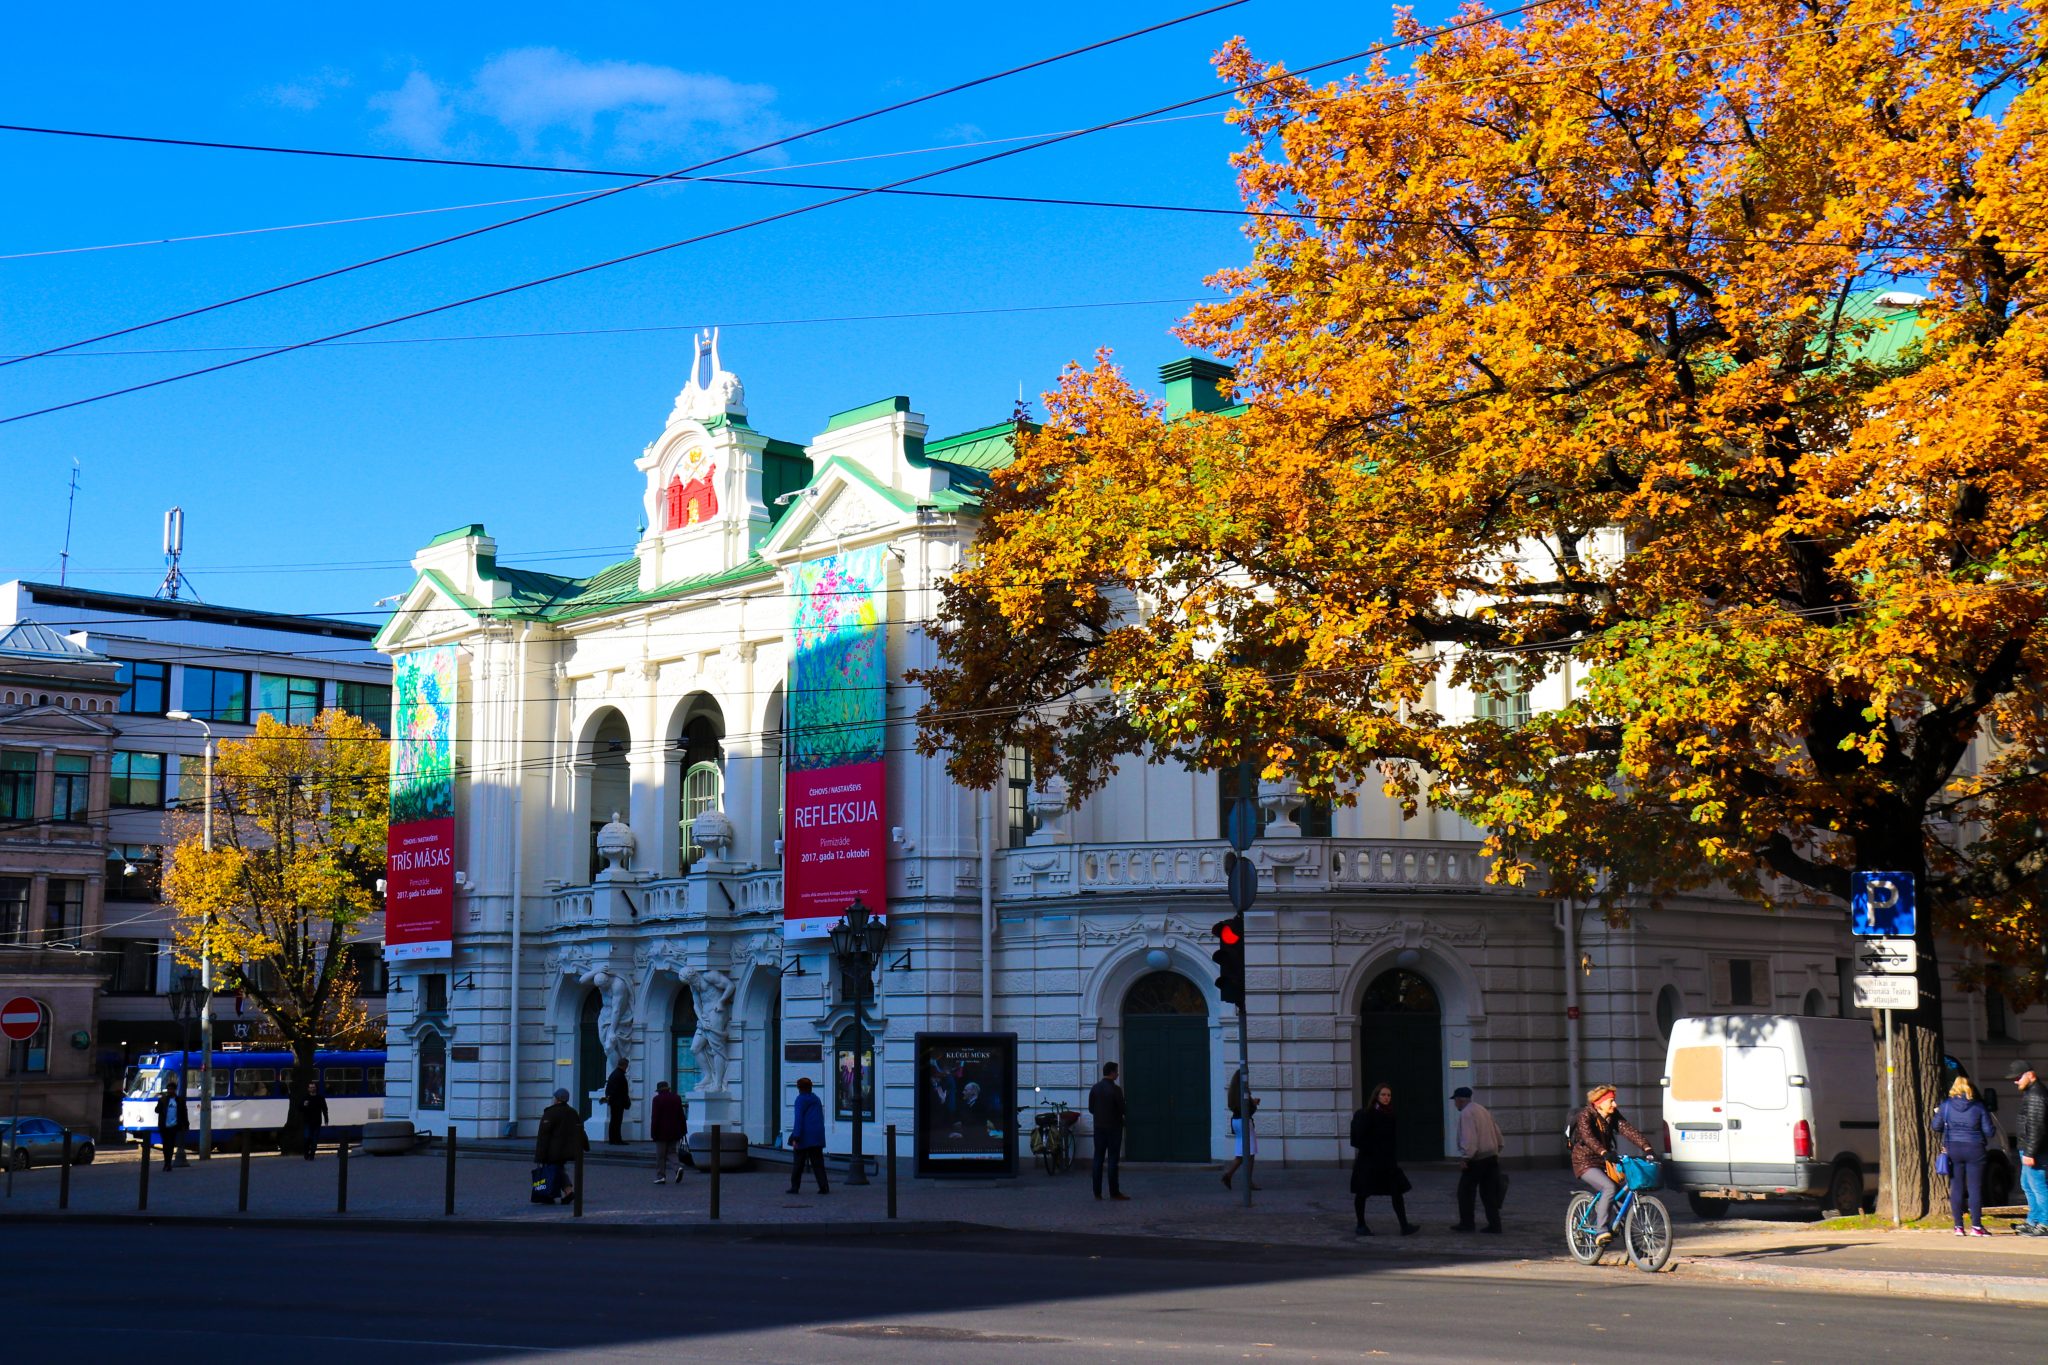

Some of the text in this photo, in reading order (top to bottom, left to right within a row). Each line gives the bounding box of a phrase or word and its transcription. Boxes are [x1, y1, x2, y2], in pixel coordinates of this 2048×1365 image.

[795, 800, 878, 828] REFLEKSIJA
[391, 847, 450, 871] TRĪS MĀSAS
[801, 852, 819, 863] 2017.
[819, 851, 834, 863] gada
[836, 850, 845, 860] 12.
[1867, 880, 1899, 927] P
